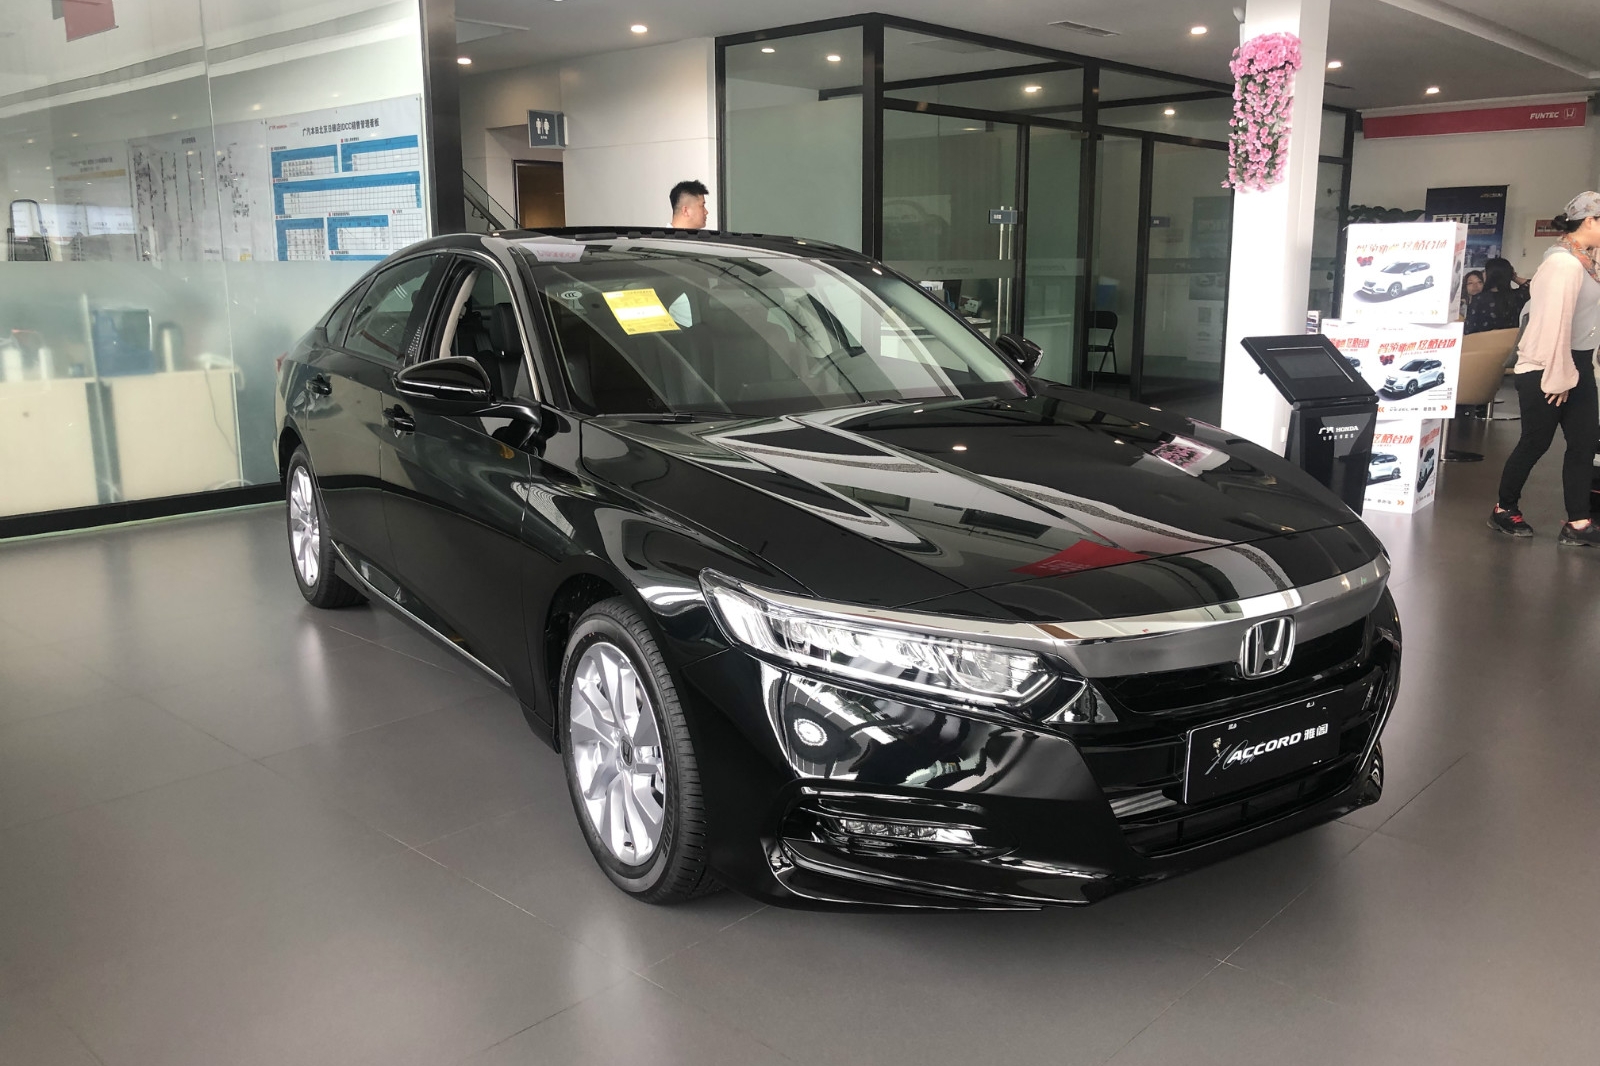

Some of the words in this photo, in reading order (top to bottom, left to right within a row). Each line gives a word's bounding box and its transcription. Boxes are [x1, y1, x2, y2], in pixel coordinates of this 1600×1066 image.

[1530, 112, 1560, 120] FUNTEC
[1335, 425, 1360, 433] HONDA
[1227, 732, 1302, 764] ACCORD
[1303, 723, 1329, 741] 雅阁
